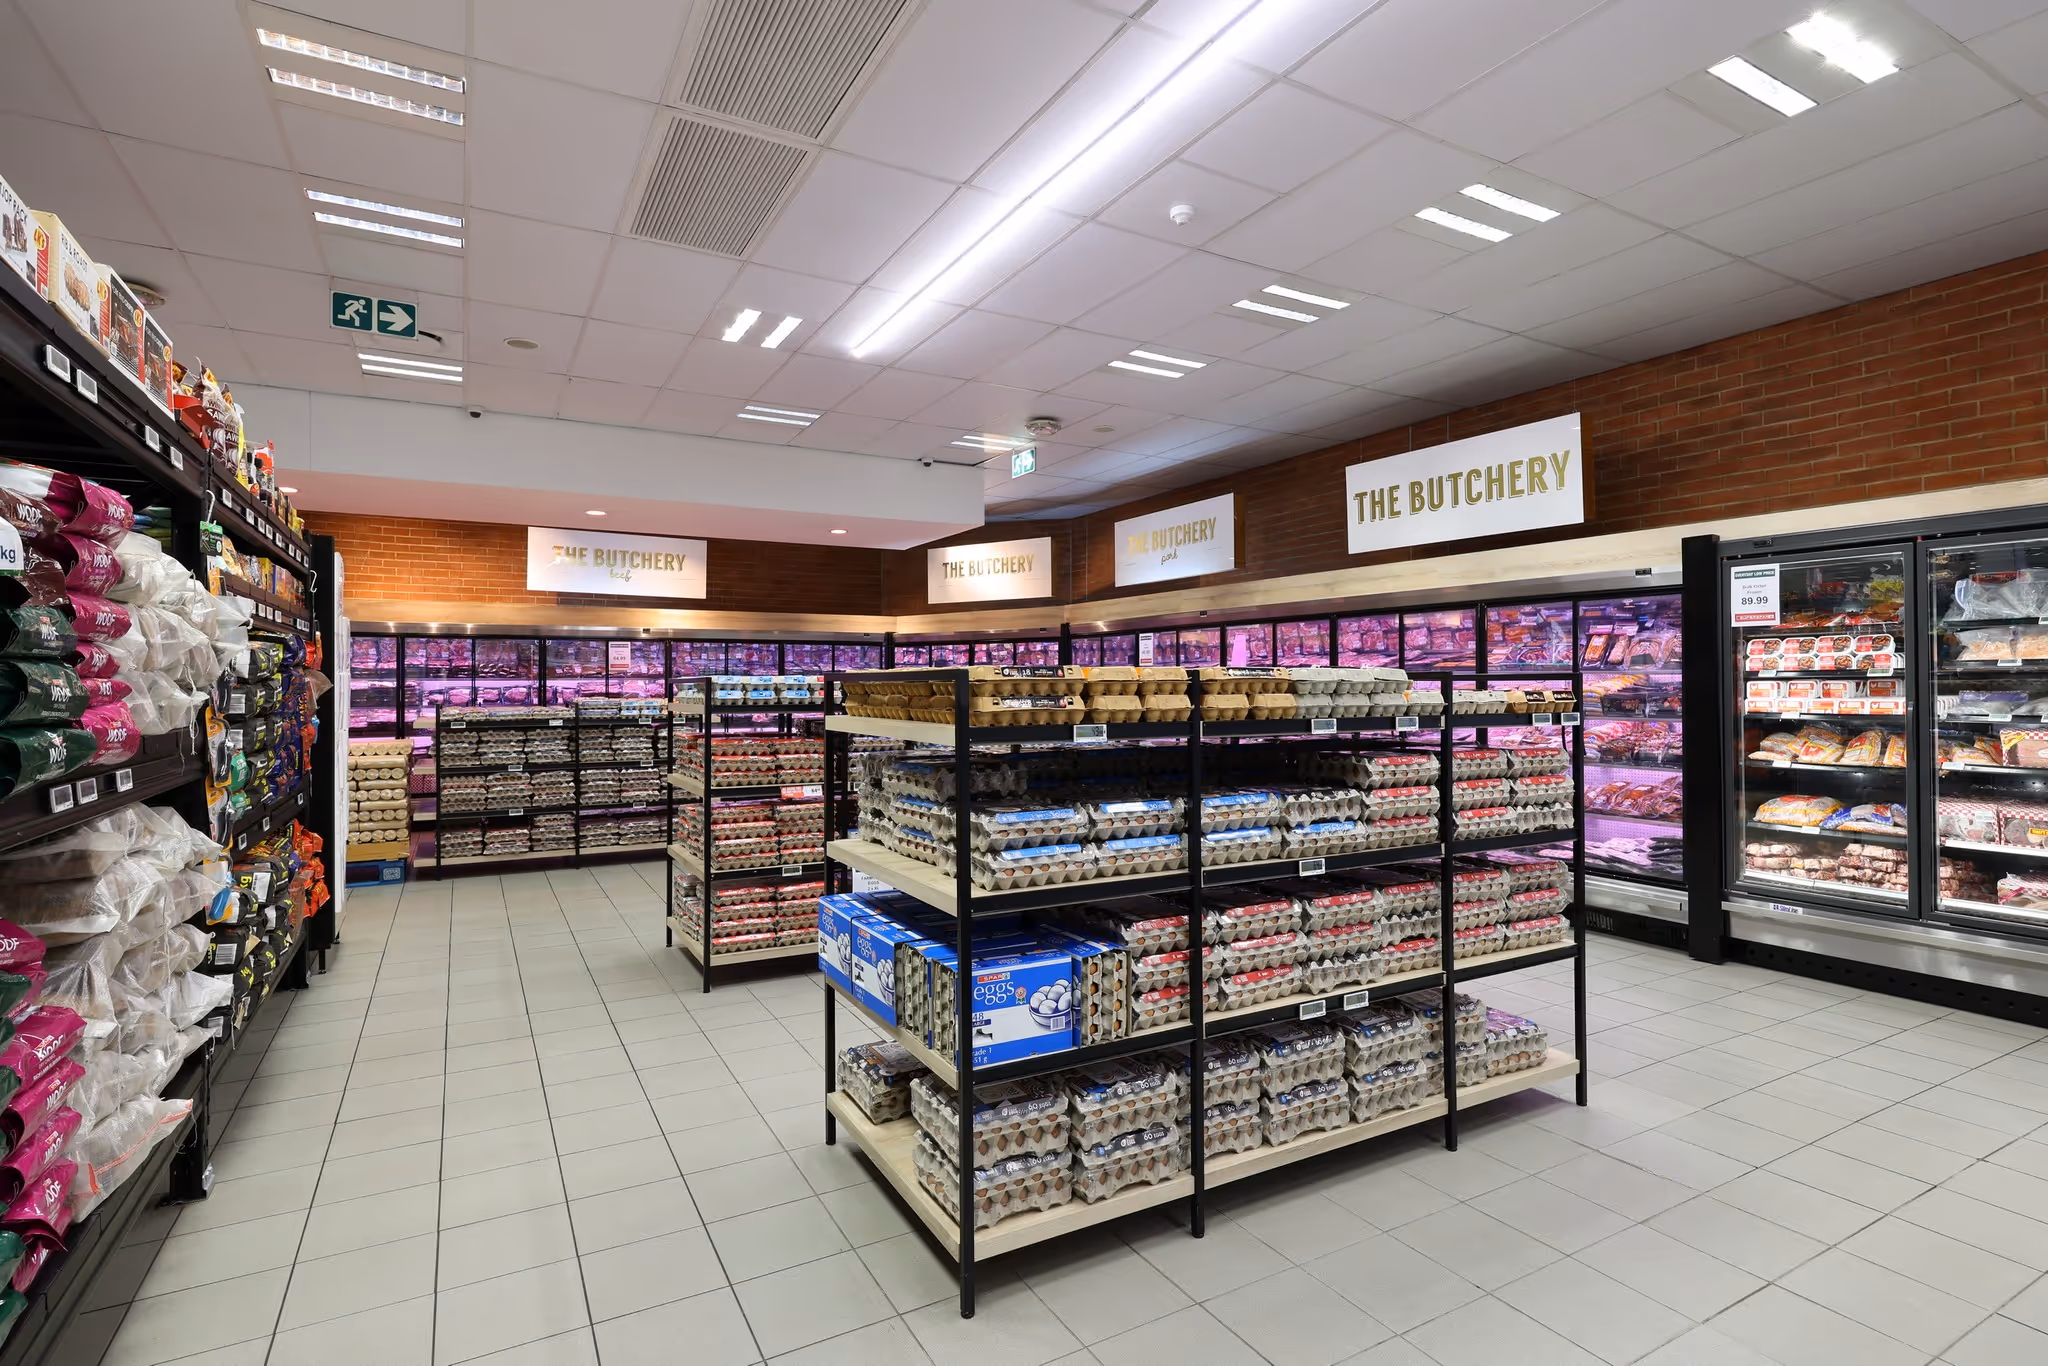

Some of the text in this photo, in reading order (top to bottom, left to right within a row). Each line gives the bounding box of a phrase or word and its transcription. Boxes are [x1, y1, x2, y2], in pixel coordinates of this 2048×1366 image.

[1353, 449, 1570, 524] THE BUTCHERY
[16, 503, 42, 522] WOOF
[1127, 516, 1217, 555] THE BUTCHERY
[0, 550, 16, 563] kg
[92, 552, 112, 568] WOOF
[552, 545, 687, 572] THE BUTCHERY
[610, 569, 632, 582] beef
[942, 554, 1034, 580] THE BUTCHERY
[1742, 596, 1768, 606] 89.99
[96, 612, 116, 626] WOOF
[106, 728, 127, 742] WOOF
[0, 938, 19, 952] OOF
[857, 936, 872, 958] eggs
[974, 982, 1014, 1005] eggs
[47, 1082, 67, 1110] WOOF
[45, 1181, 61, 1206] OOF
